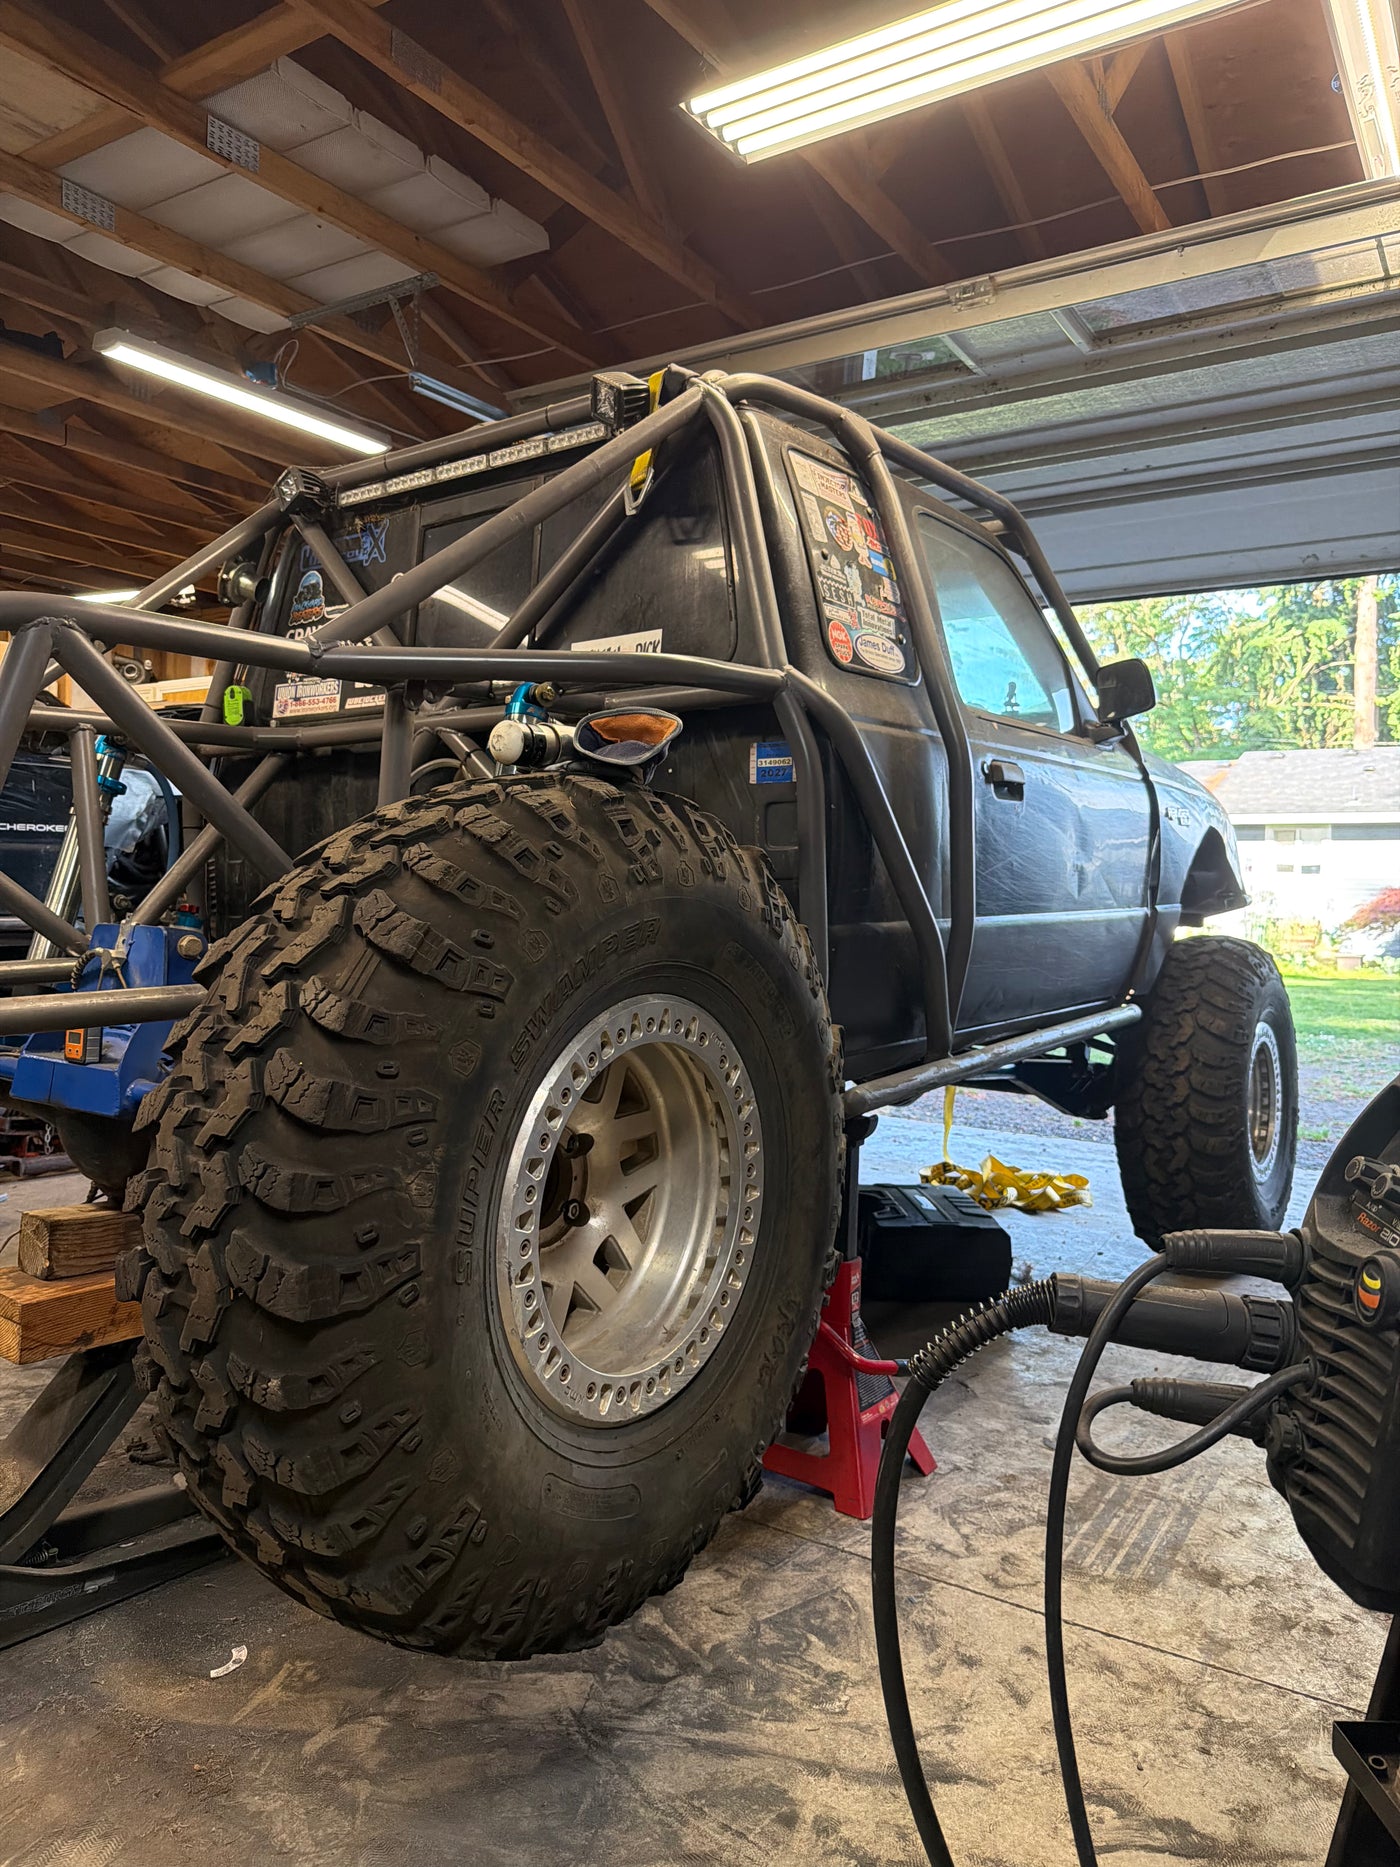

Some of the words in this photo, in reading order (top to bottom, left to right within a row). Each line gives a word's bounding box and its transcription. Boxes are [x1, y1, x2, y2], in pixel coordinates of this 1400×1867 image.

[823, 584, 854, 608] SESH
[832, 629, 848, 642] NGK
[860, 636, 880, 651] James
[881, 642, 895, 656] Duff
[297, 680, 339, 698] IRONWORKERS
[453, 1088, 509, 1287] SUPER
[509, 915, 665, 1073] SWAMPER
[1357, 1211, 1381, 1233] Razor
[1380, 1227, 1400, 1247] 210
